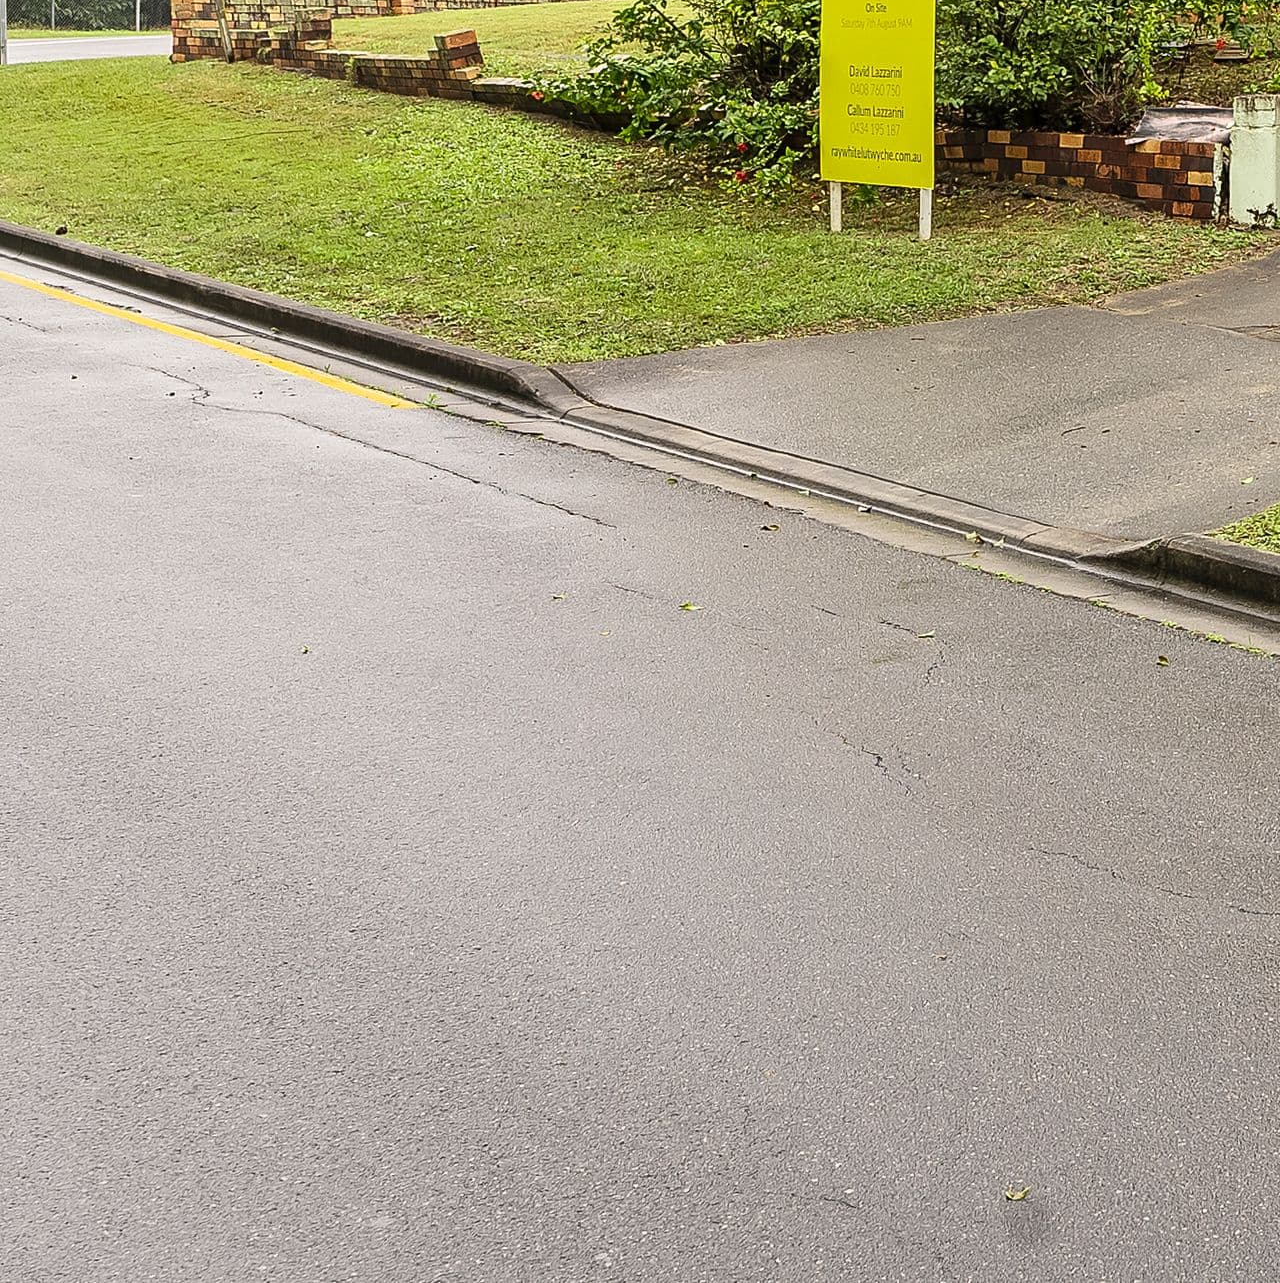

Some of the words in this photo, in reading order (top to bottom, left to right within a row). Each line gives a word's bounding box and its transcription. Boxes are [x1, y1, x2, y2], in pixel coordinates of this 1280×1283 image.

[865, 2, 875, 13] On
[875, 2, 887, 13] Site
[849, 65, 870, 77] David
[871, 65, 903, 79] Lazzarini
[847, 103, 871, 117] Callum
[872, 104, 904, 119] Lazzarini
[831, 145, 922, 163] raywhitelutwyche.com.au
